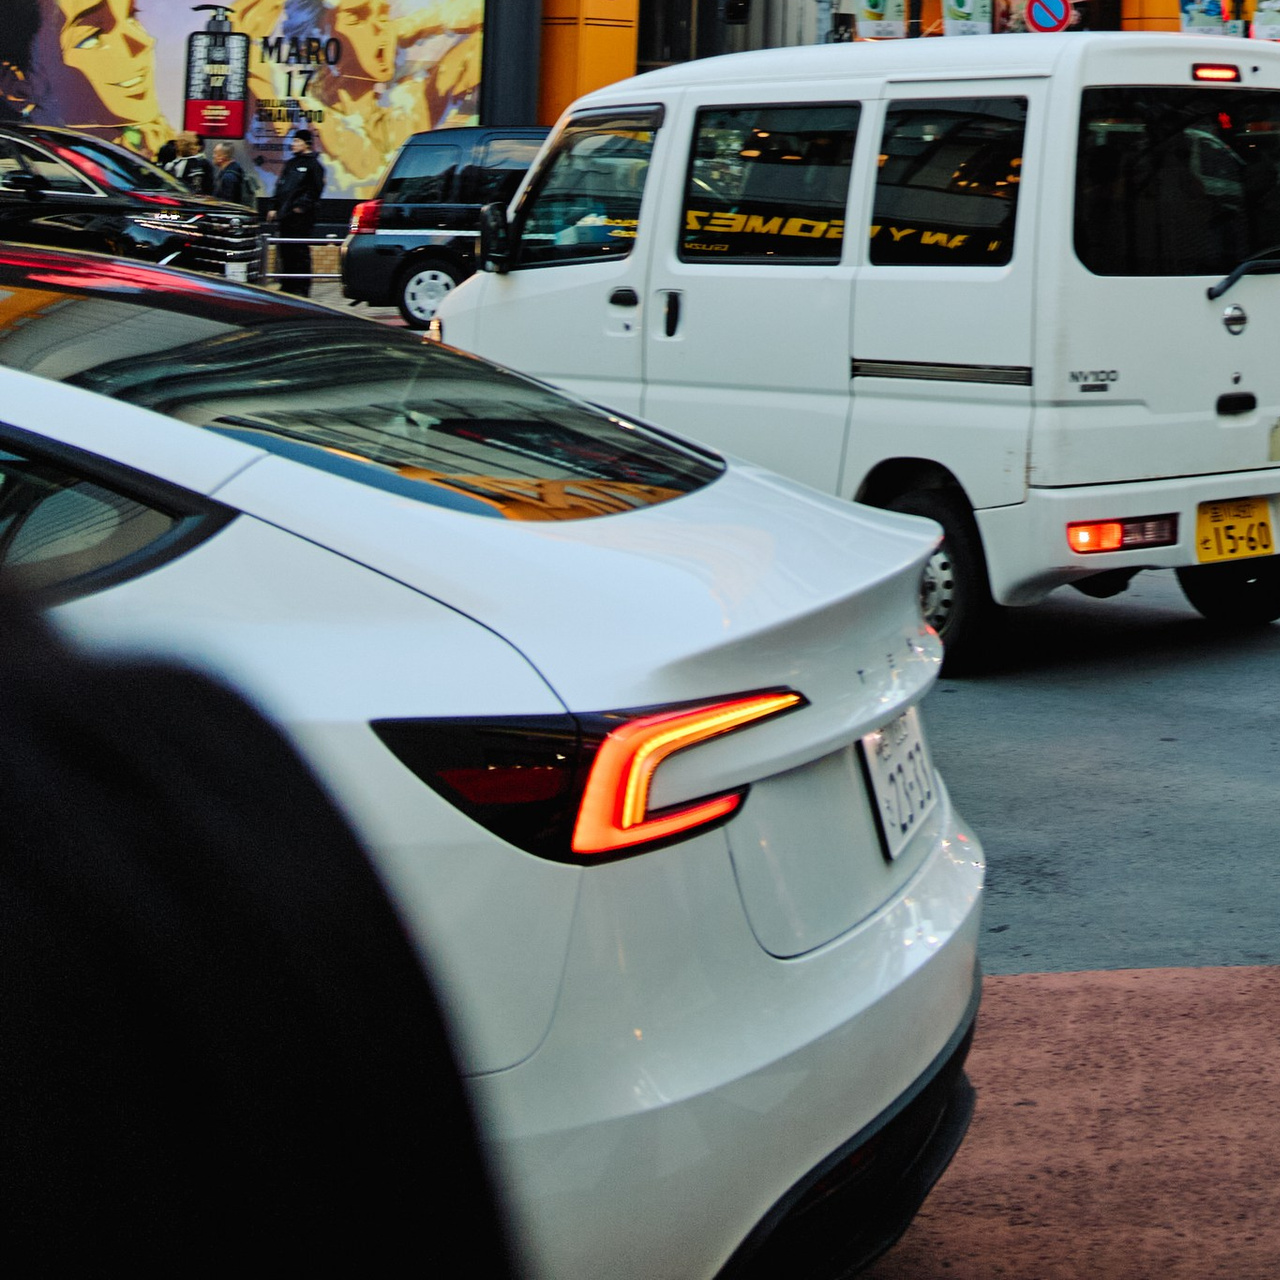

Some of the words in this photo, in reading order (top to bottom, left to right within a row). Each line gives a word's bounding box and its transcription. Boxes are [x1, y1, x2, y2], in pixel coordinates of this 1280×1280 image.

[260, 36, 341, 66] MARO
[285, 70, 315, 98] 17
[256, 109, 325, 123] SHAMPOO
[1069, 369, 1119, 383] NV100
[1213, 521, 1272, 557] 15-60
